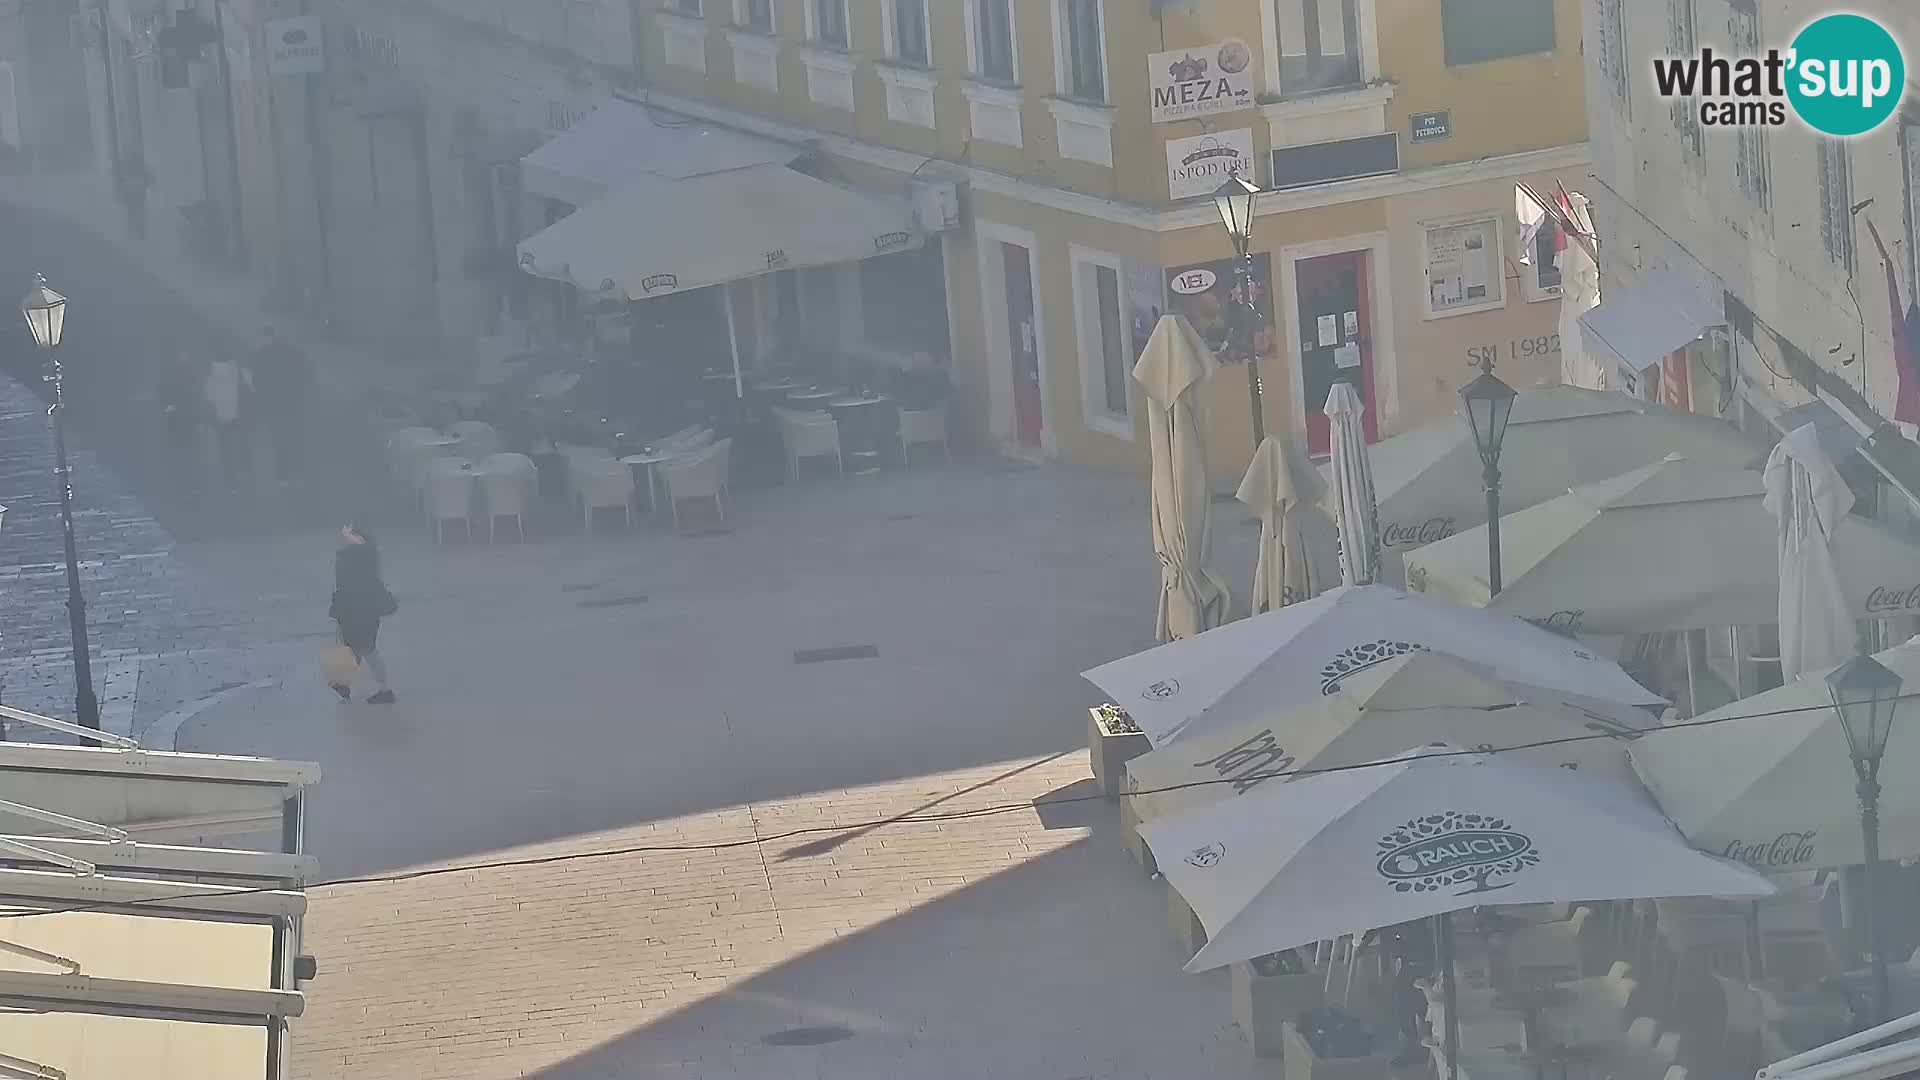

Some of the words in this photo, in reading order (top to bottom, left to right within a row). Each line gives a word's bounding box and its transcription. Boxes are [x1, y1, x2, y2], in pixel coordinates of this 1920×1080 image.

[1154, 77, 1232, 108] MEZA
[1173, 163, 1218, 181] ISPOD
[1466, 344, 1497, 367] SM
[1508, 334, 1561, 361] 1982
[1416, 836, 1514, 867] RAUCH
